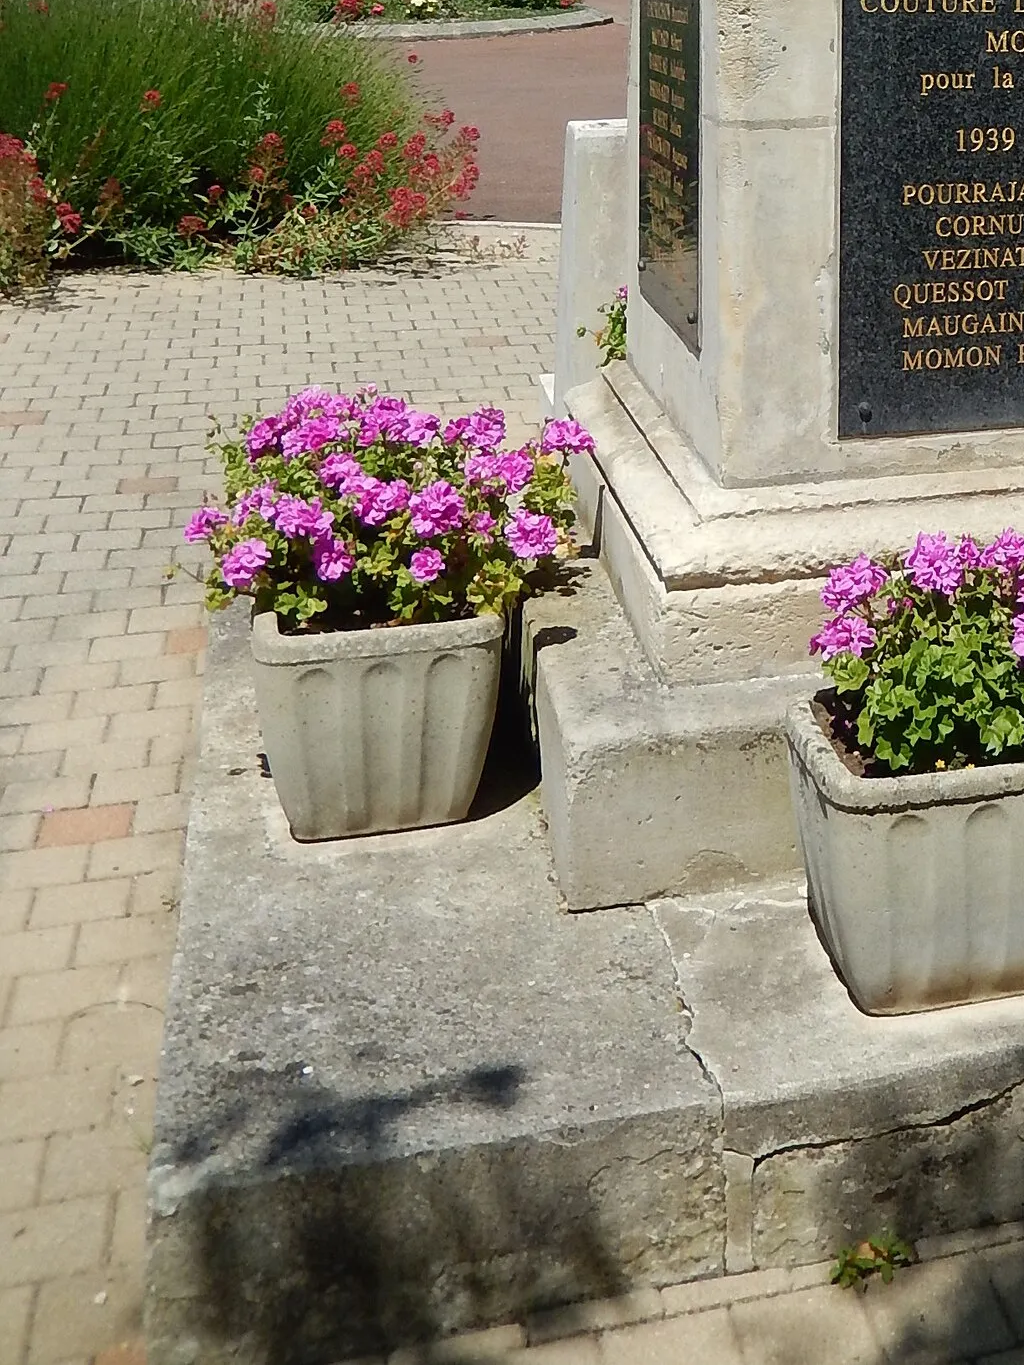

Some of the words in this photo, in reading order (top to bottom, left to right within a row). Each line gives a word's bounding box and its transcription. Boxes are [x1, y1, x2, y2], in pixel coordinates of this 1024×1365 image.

[920, 73, 975, 96] pour
[993, 68, 1014, 89] la
[955, 127, 1015, 152] 1939
[935, 214, 1024, 238] CORNU
[893, 279, 1009, 309] QUESSOT
[902, 311, 1024, 338] MAUGAIN
[902, 344, 1002, 371] MOMON
